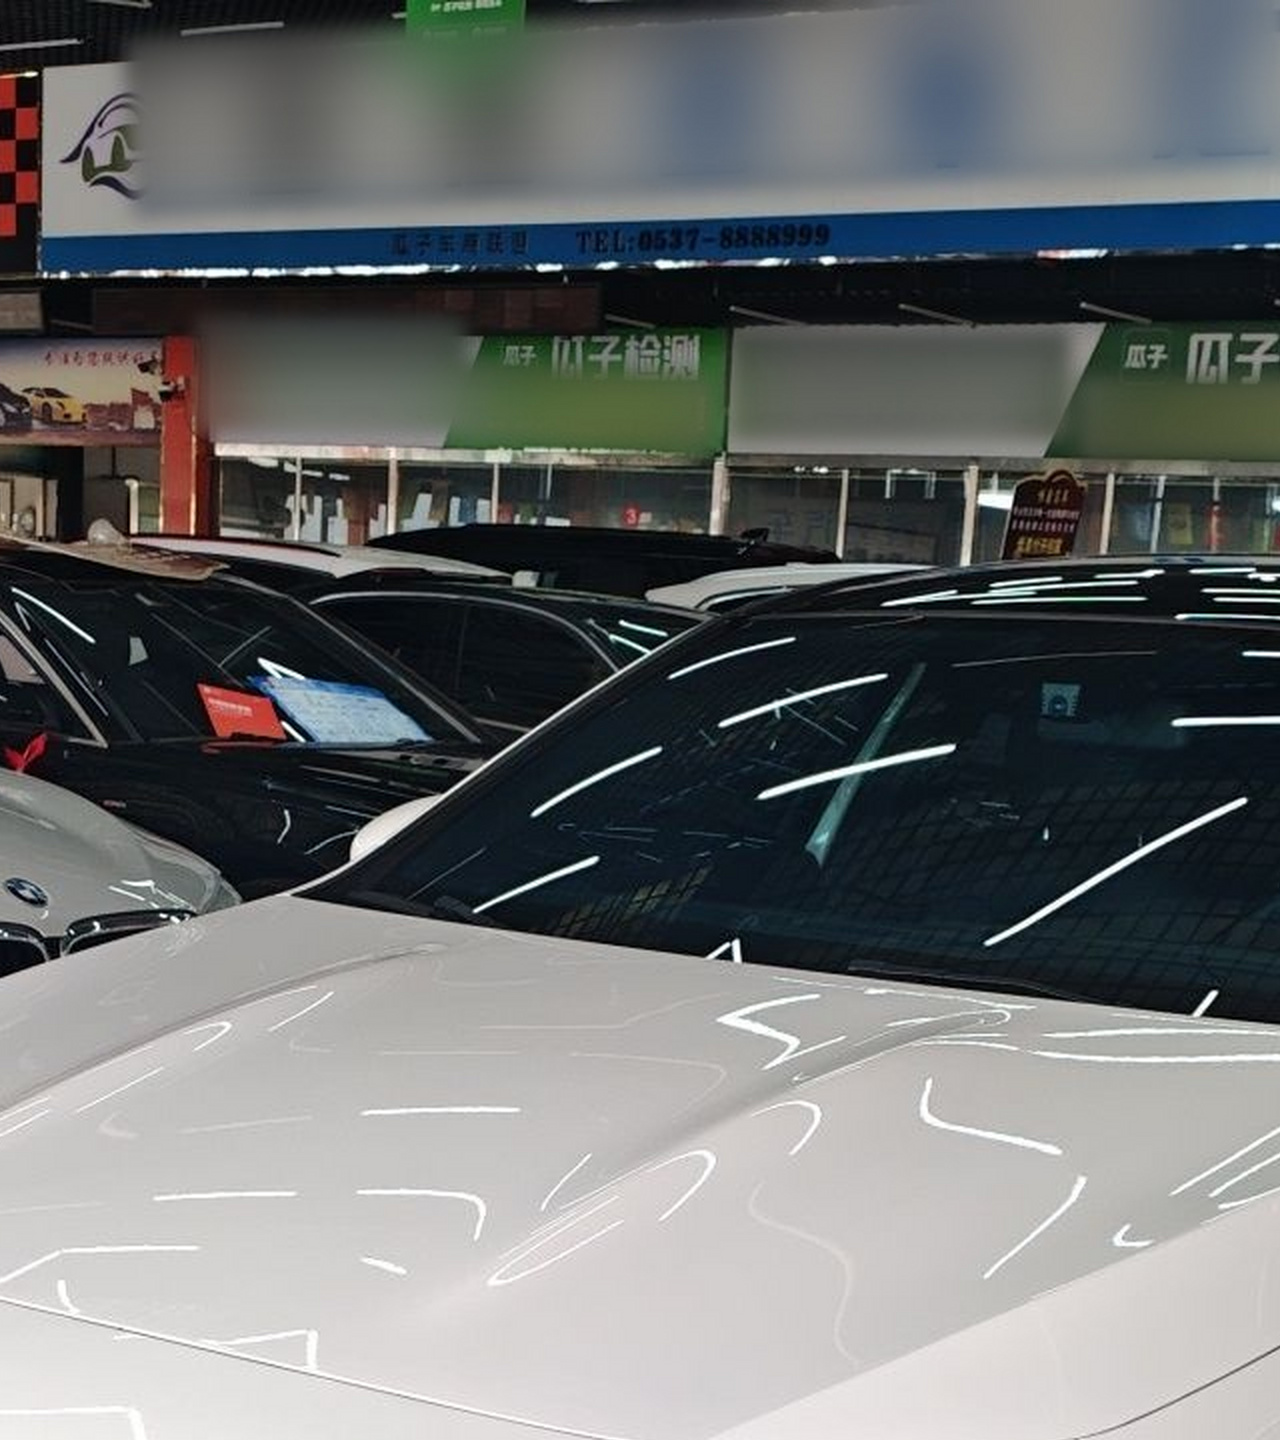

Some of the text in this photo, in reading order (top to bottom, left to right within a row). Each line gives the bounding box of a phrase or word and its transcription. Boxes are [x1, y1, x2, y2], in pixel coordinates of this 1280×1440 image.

[550, 334, 701, 381] 瓜子检测
[1125, 344, 1169, 370] 瓜子
